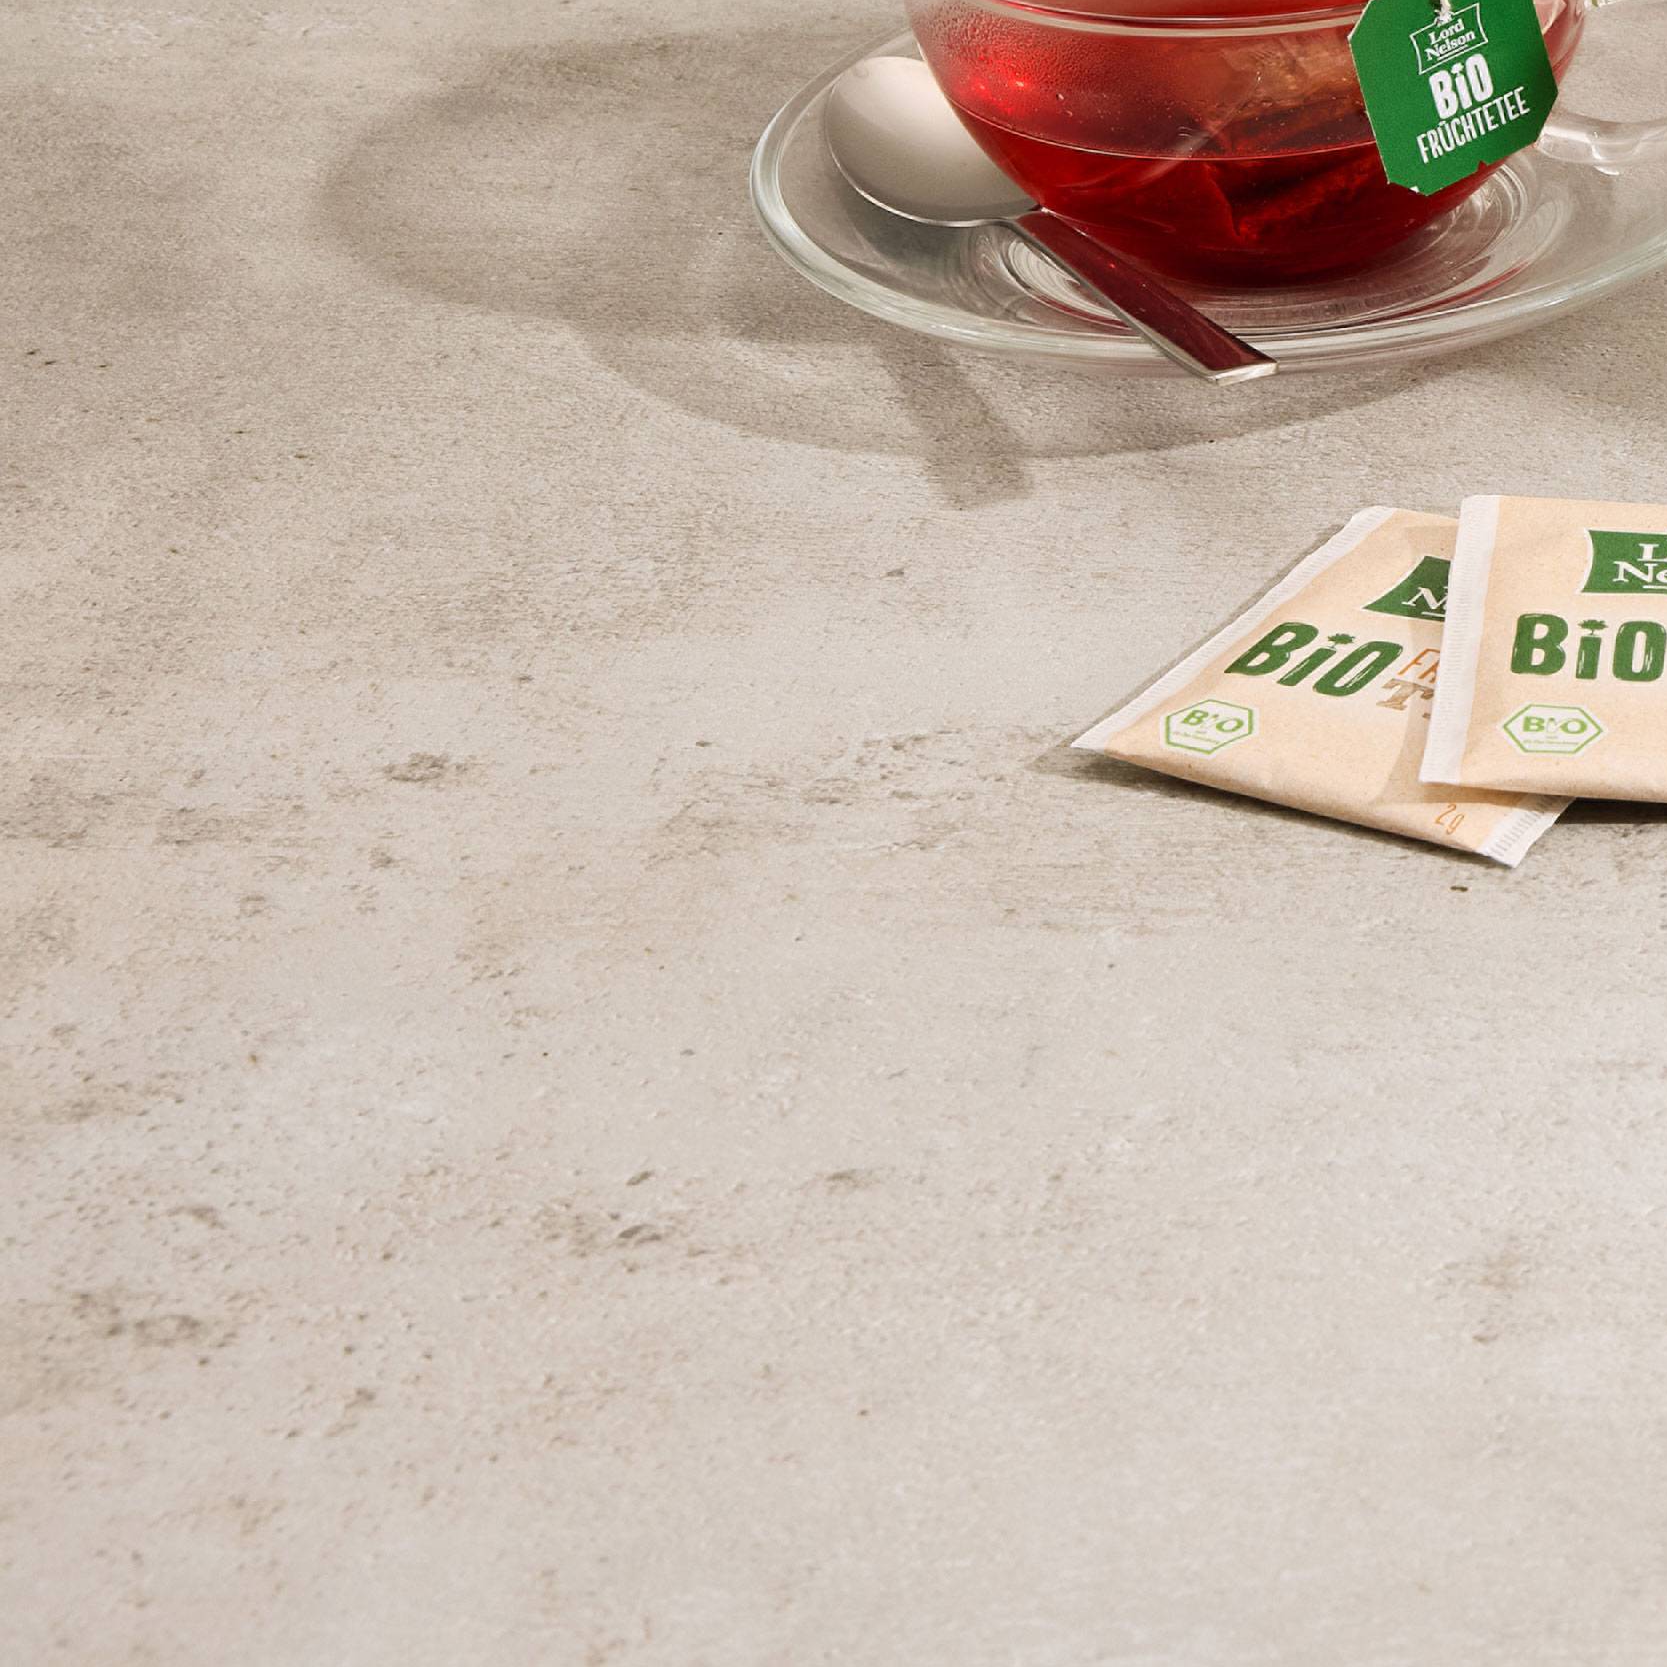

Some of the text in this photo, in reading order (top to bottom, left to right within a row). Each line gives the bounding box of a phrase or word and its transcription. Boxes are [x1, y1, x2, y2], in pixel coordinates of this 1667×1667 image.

[1424, 30, 1476, 61] Nelson
[1429, 18, 1464, 45] Lord
[1416, 86, 1530, 164] FRÜCHTETEE
